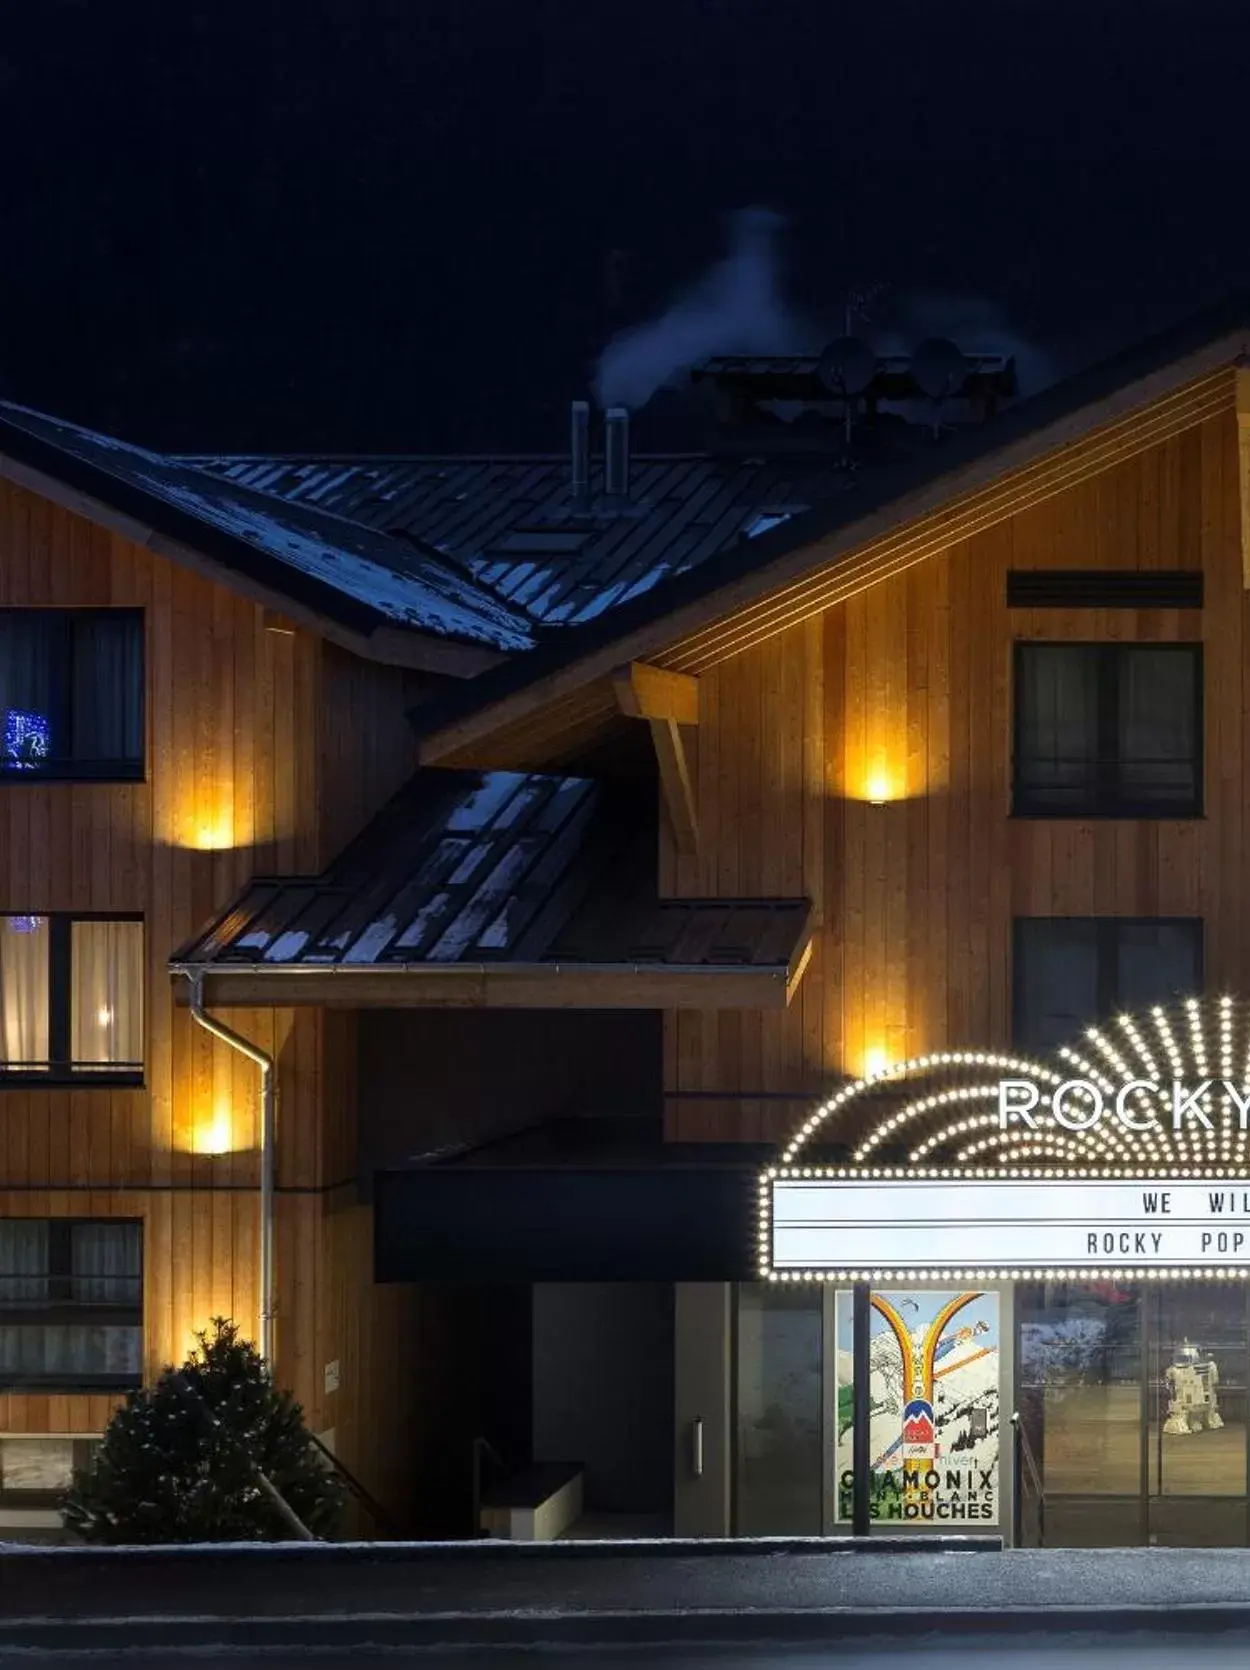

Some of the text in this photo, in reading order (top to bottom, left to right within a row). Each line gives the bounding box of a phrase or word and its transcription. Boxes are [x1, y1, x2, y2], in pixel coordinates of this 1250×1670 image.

[1142, 1192, 1171, 1213] WE
[1087, 1232, 1163, 1254] ROCKY
[1201, 1232, 1245, 1253] POP
[841, 1491, 993, 1502] MNT-BLANC
[841, 1503, 993, 1519] LS HOUCHES
